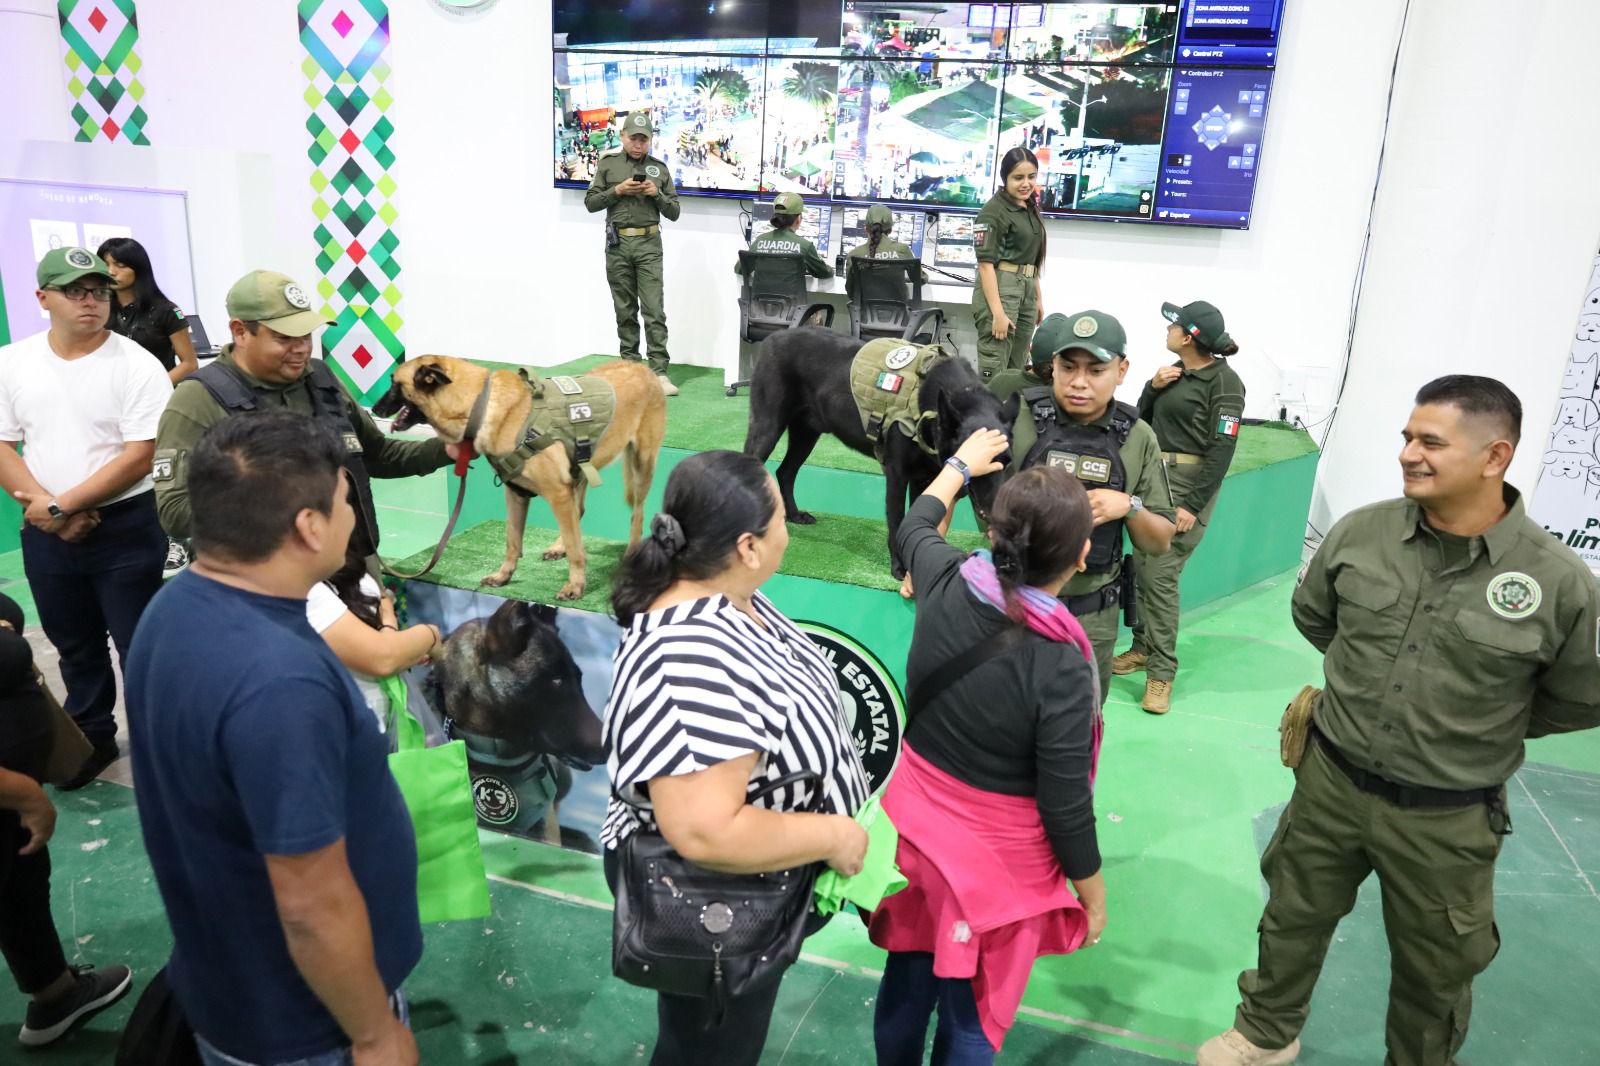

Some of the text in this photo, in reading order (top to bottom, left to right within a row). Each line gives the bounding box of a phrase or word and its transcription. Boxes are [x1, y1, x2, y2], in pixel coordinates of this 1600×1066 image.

[757, 240, 801, 253] GUARDIA
[1082, 460, 1108, 474] GCE
[840, 661, 890, 755] ESTATAL
